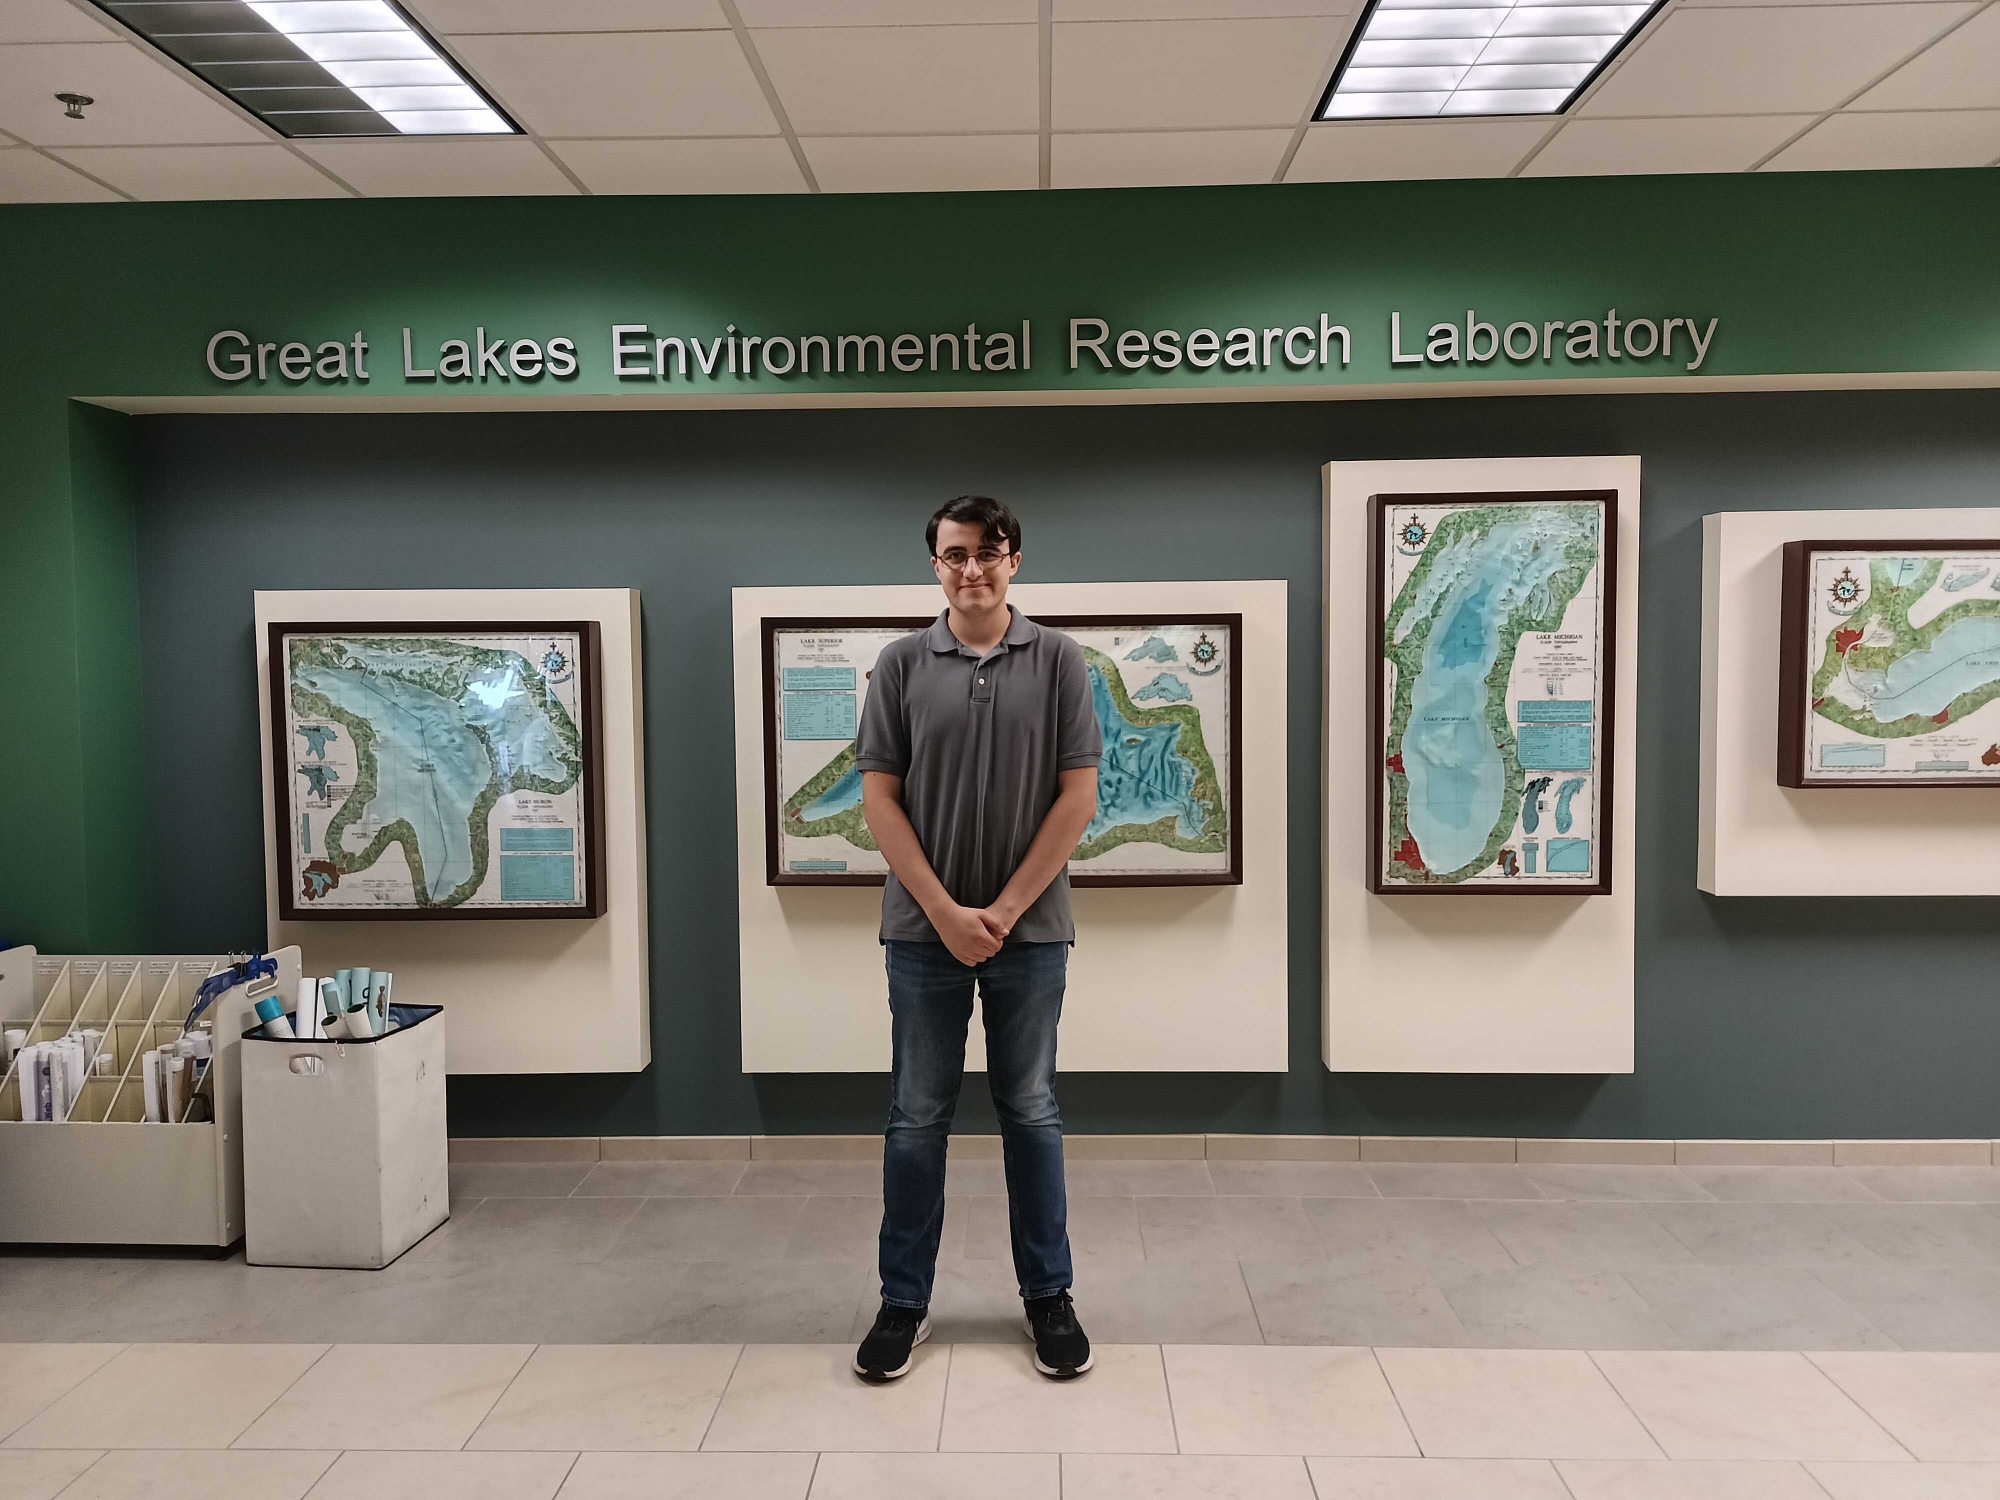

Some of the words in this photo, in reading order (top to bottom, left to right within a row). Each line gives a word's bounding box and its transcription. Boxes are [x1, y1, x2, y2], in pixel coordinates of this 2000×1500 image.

[205, 329, 370, 383] Great
[402, 325, 578, 380] Lakes
[612, 319, 1031, 379] Environmental
[1069, 312, 1351, 371] Research
[1391, 308, 1720, 372] Laboratory
